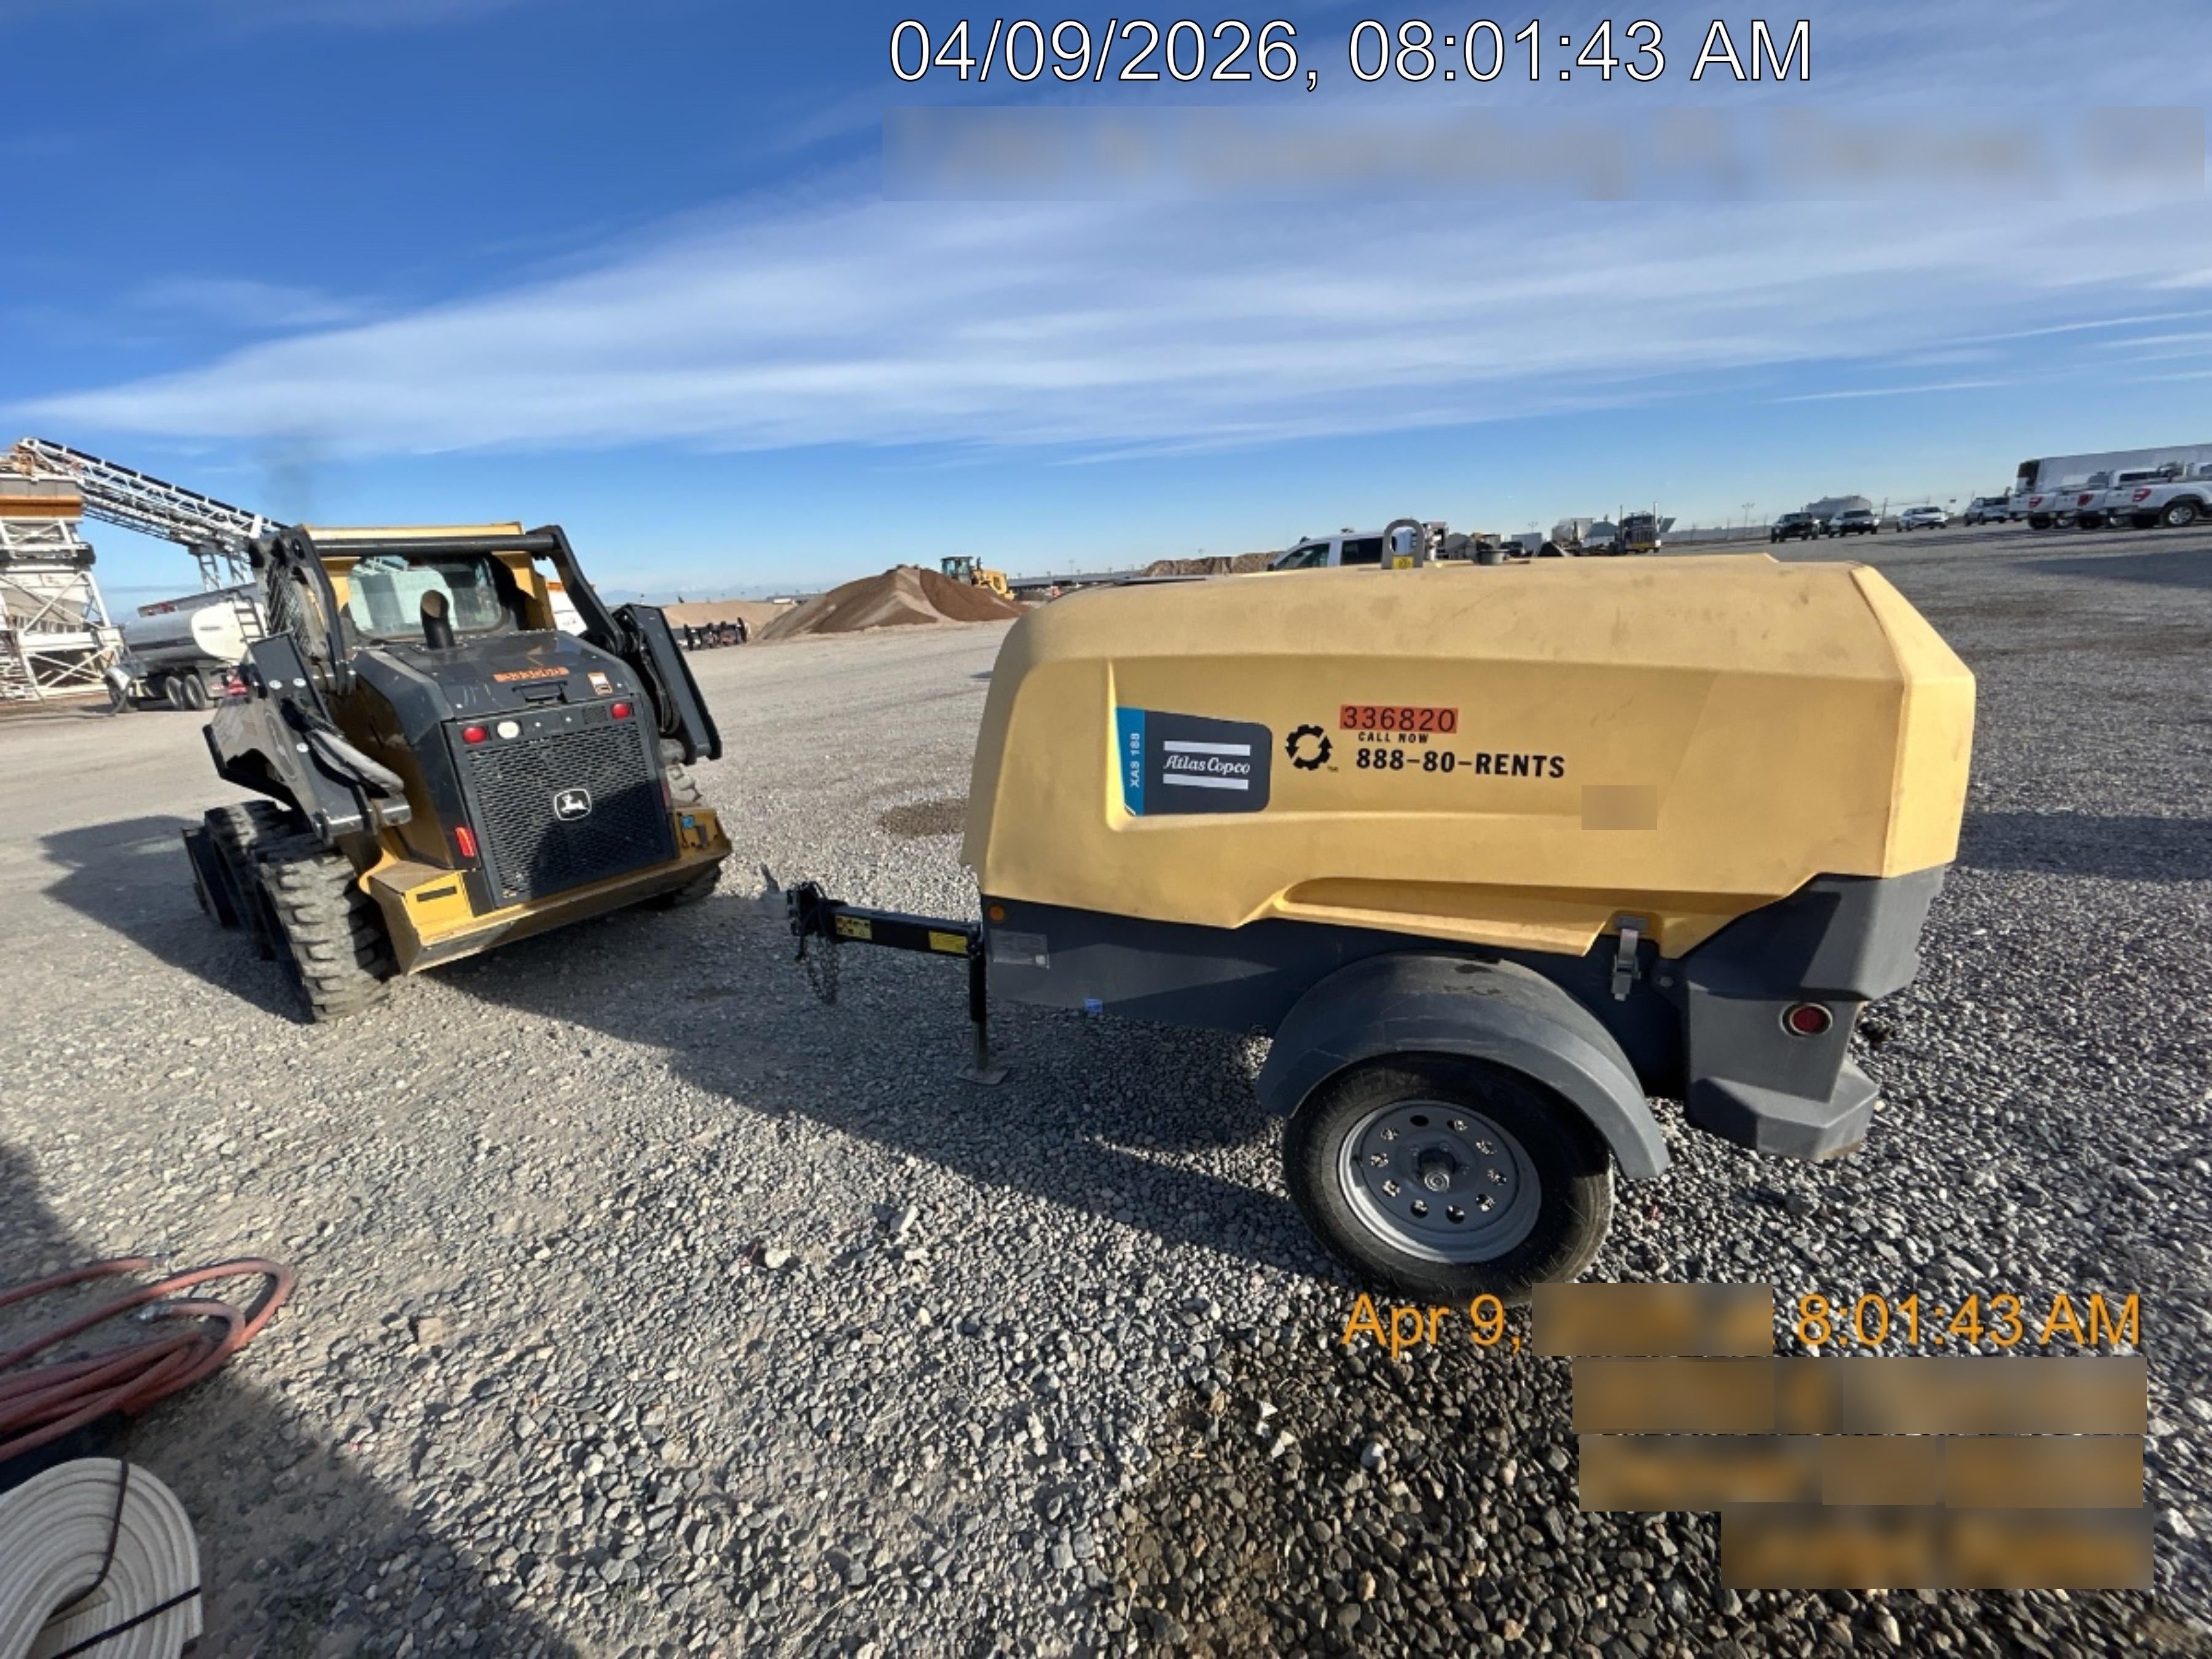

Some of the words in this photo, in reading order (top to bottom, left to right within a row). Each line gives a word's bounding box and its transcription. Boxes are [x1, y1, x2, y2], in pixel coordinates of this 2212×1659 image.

[1343, 707, 1455, 732] 336820
[1358, 732, 1391, 742] CALL
[1398, 733, 1429, 743] NOW
[1130, 761, 1140, 788] XAS
[1356, 748, 1566, 779] 888-80-RENTS
